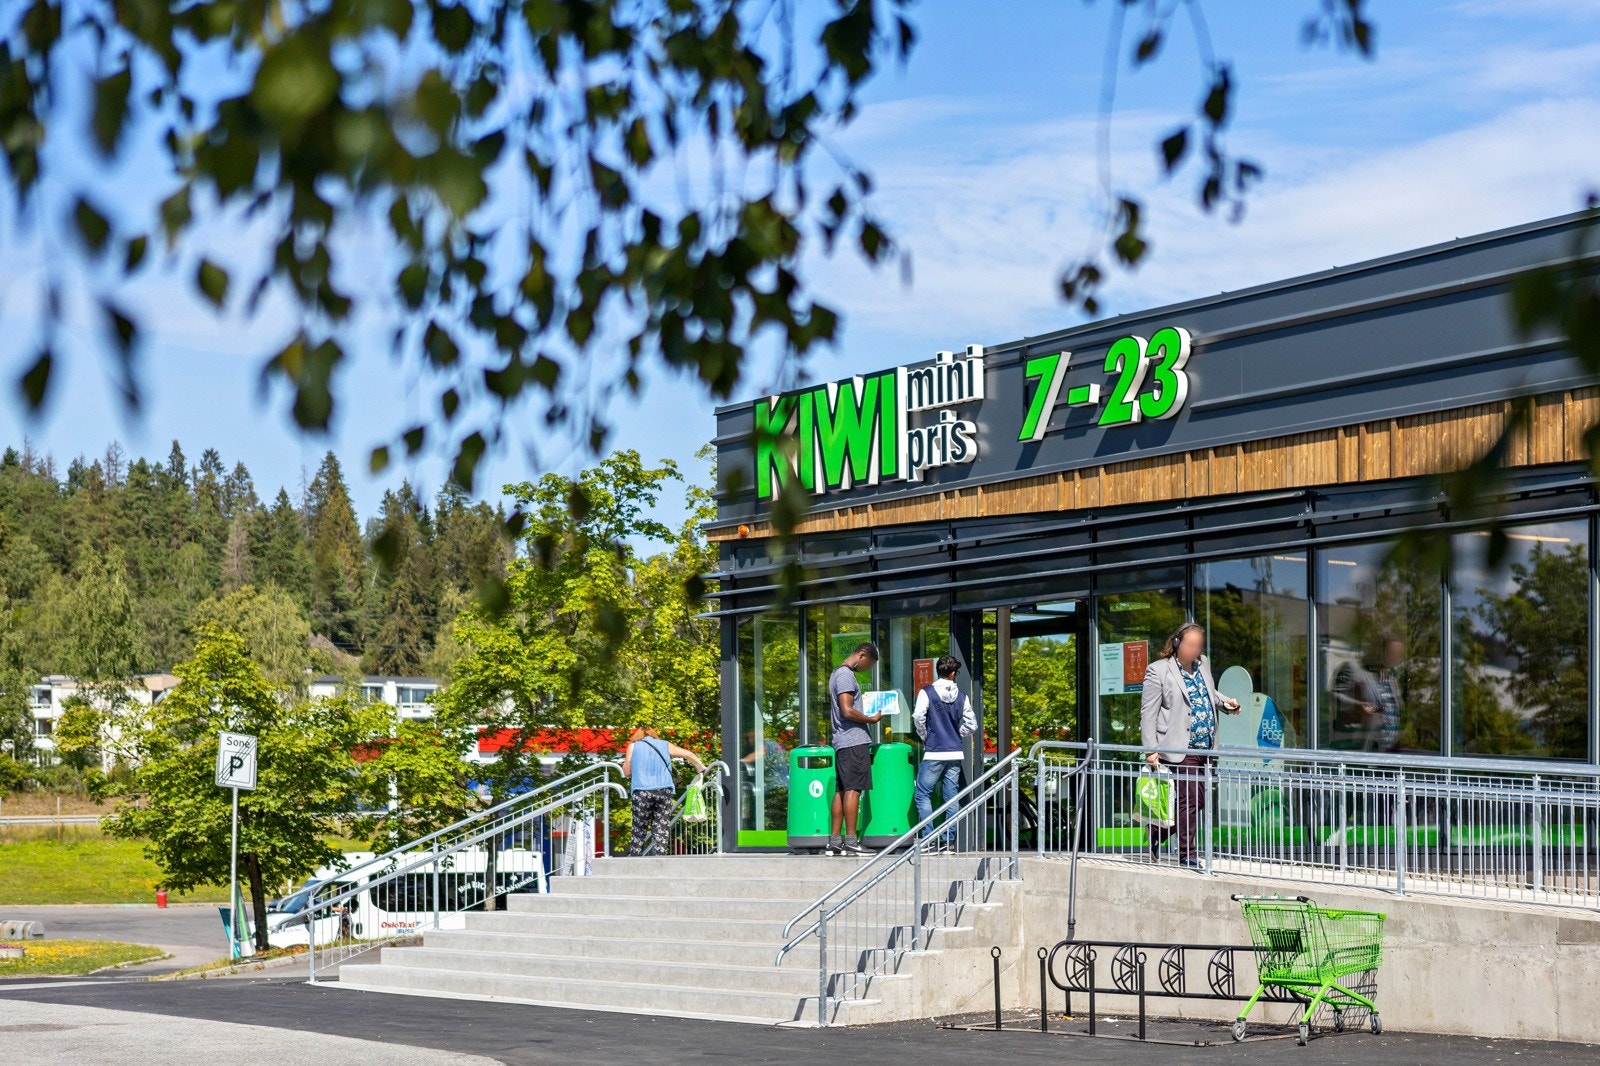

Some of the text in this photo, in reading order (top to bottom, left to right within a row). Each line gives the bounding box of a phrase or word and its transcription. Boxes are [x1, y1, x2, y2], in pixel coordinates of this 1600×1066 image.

[907, 345, 983, 411] mini
[754, 367, 900, 500] KIWI
[907, 410, 977, 482] pris
[226, 736, 251, 748] Sone
[1262, 715, 1277, 730] BLÅ
[230, 756, 243, 777] P
